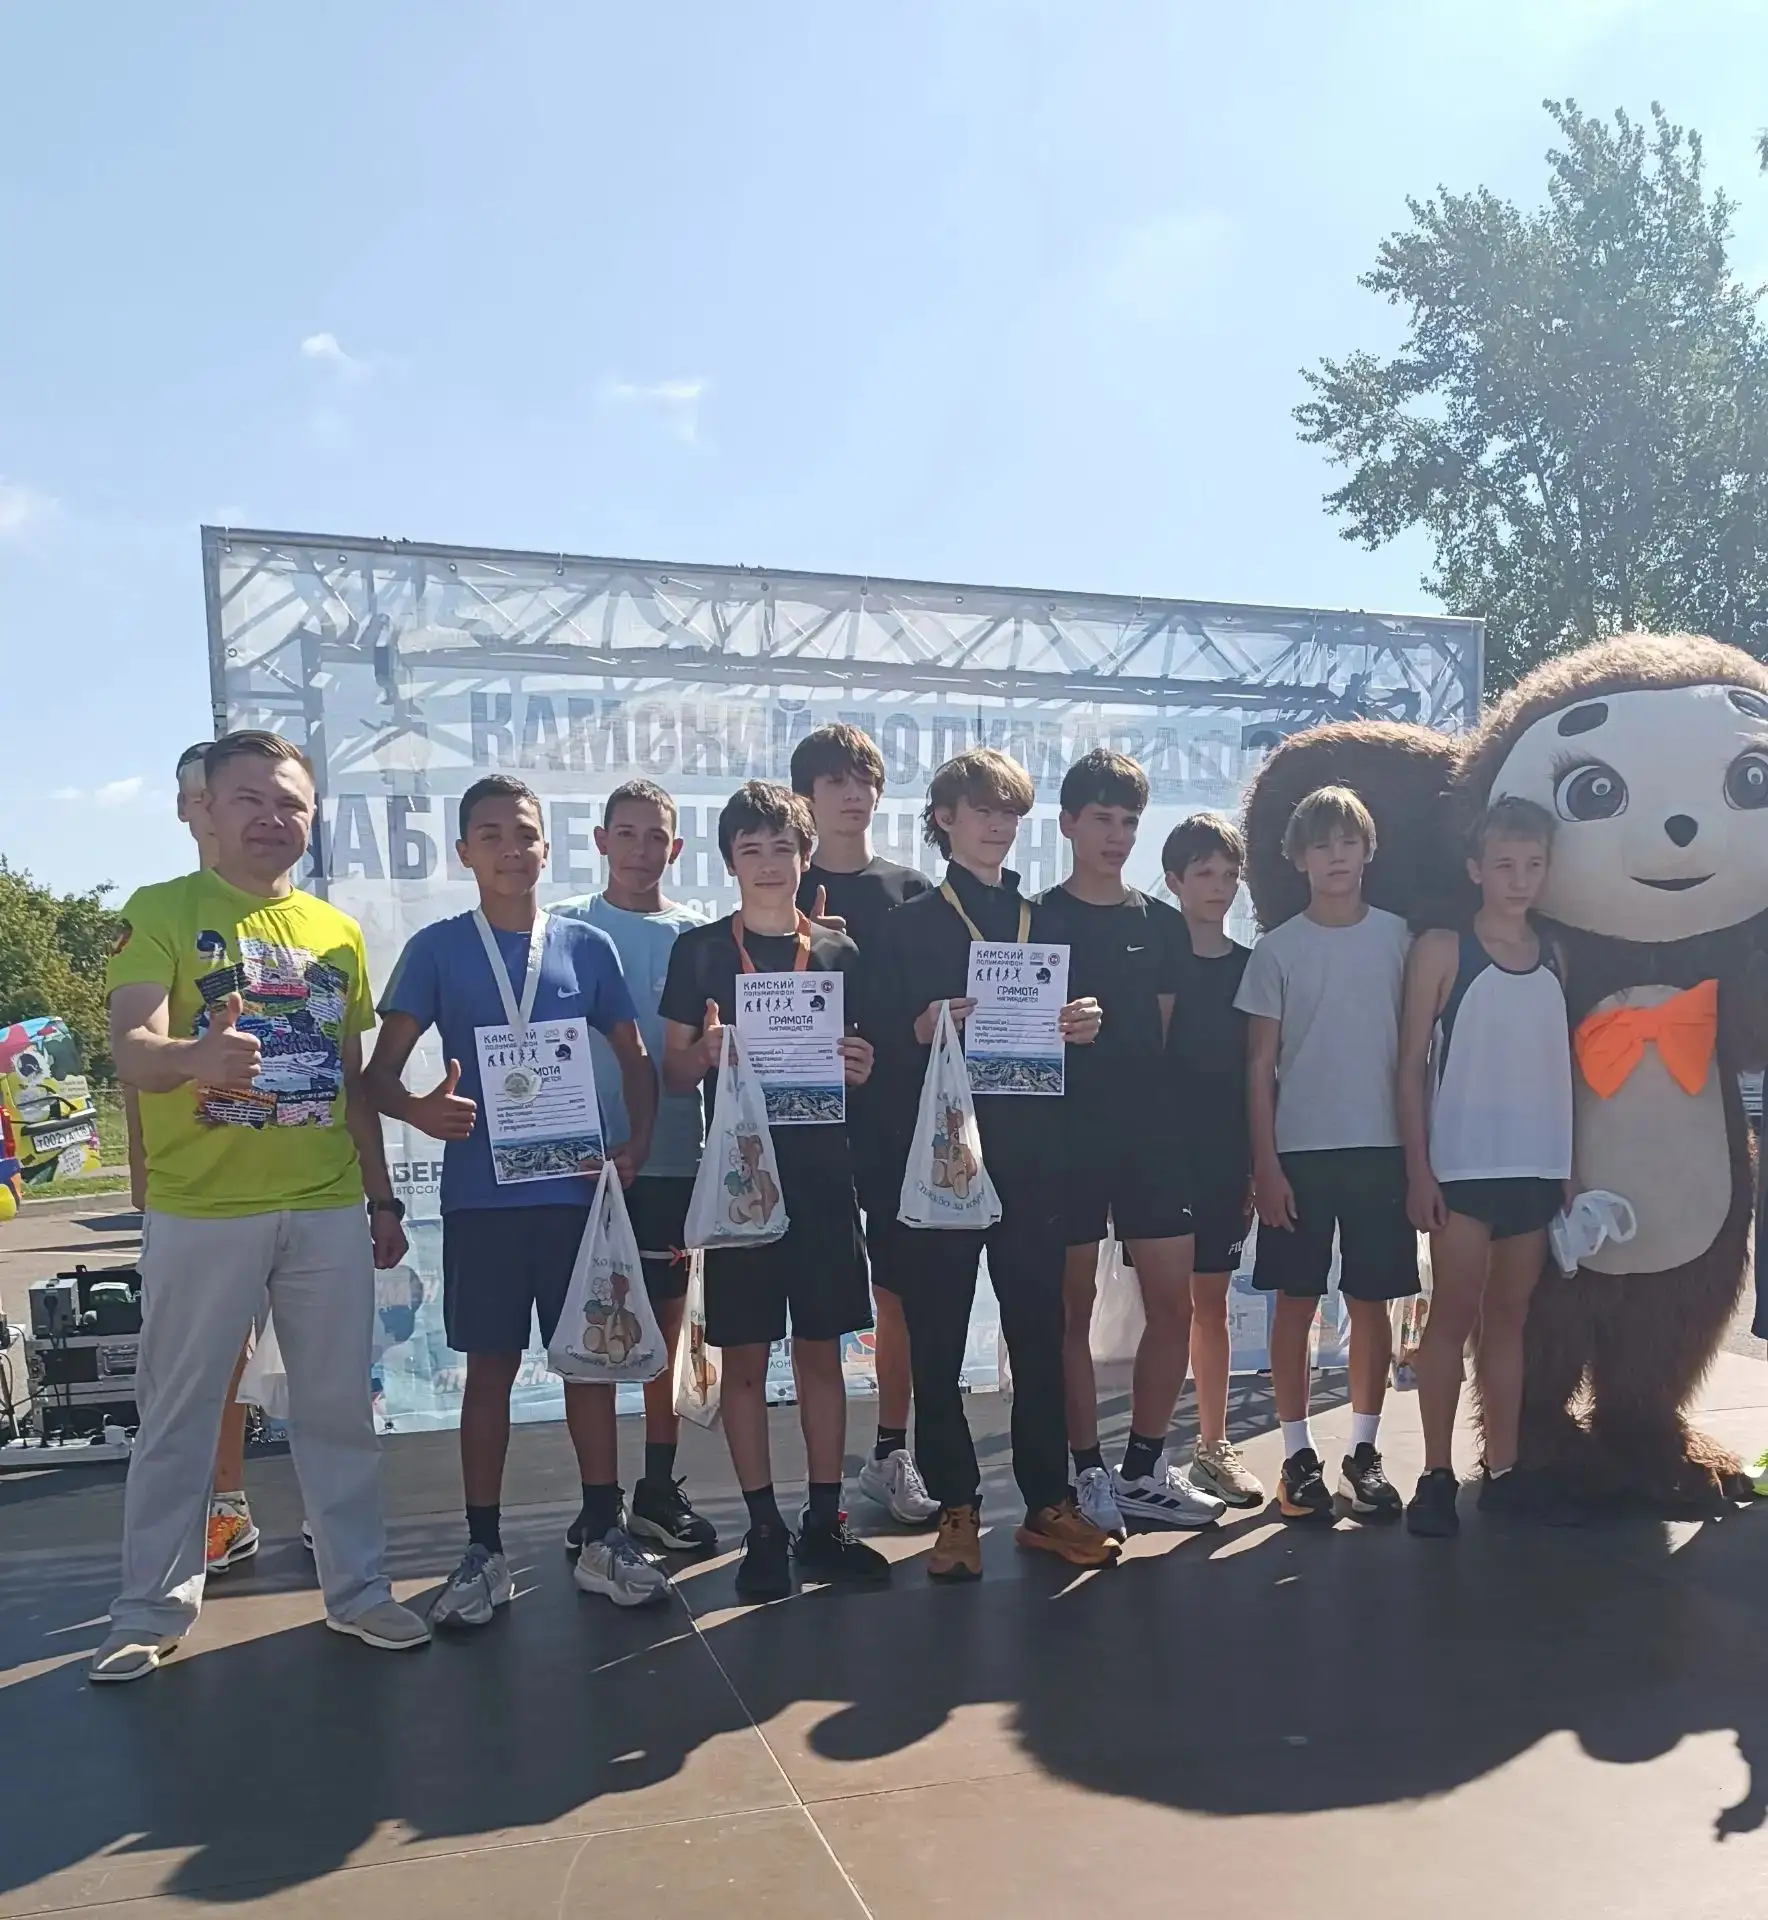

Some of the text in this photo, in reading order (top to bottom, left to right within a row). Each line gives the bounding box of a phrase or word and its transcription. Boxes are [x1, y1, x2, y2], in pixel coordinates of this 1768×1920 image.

[469, 691, 812, 779] КАМСКИЙ
[976, 949, 1023, 960] КАМСКИЙ
[976, 959, 1023, 967] ПОЛУМАРАФОН
[743, 978, 795, 990] КАМСКИЙ
[743, 989, 795, 997] ПОЛУМАРАФОН
[997, 986, 1038, 996] ГРАМОТА
[768, 1015, 813, 1025] ГРАМОТА
